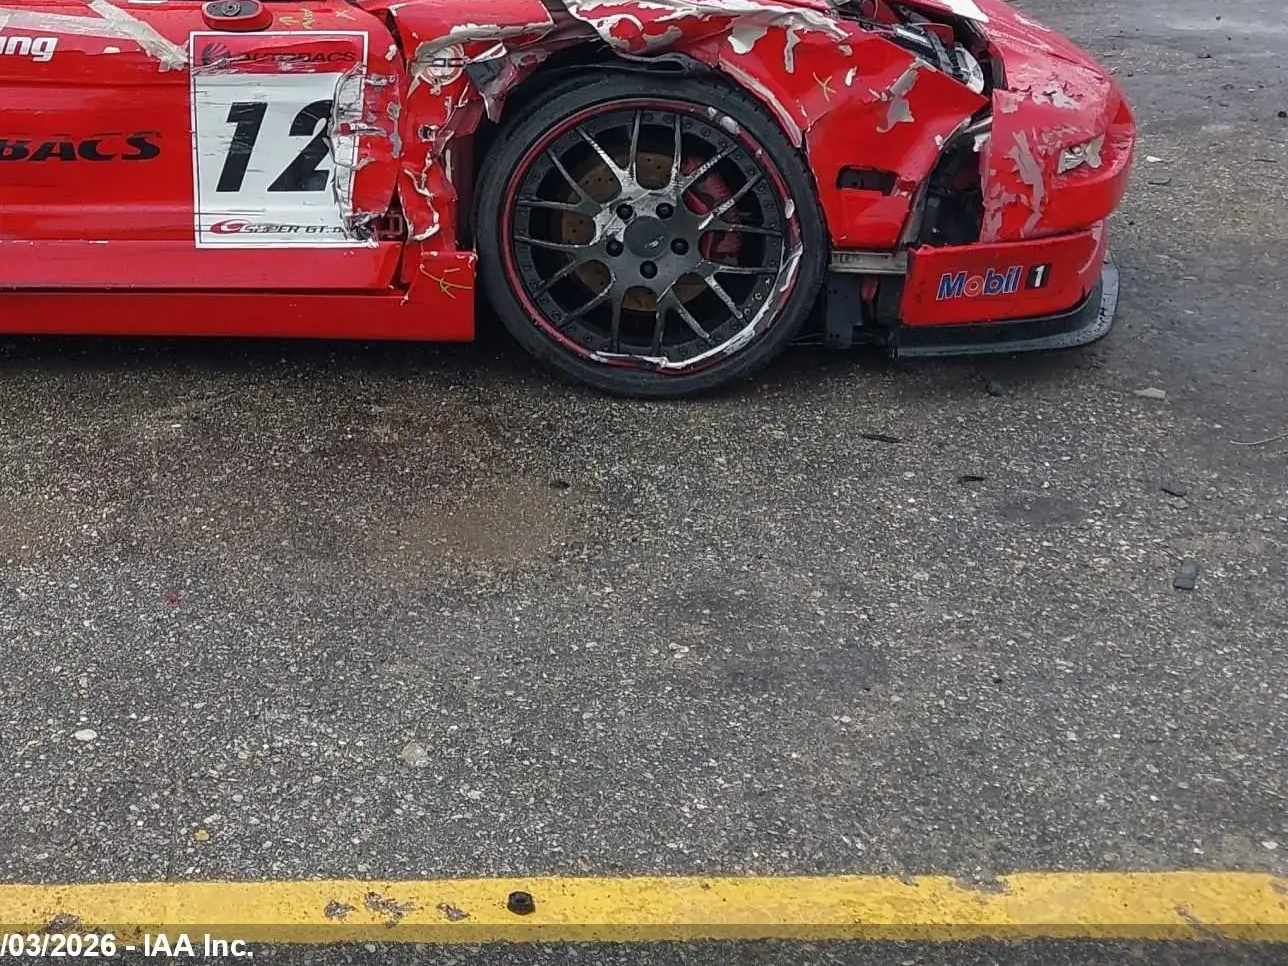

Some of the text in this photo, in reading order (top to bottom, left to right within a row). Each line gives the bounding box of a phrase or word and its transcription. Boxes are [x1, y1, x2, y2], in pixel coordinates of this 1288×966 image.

[215, 99, 334, 193] 12
[936, 264, 1046, 301] Mobil 1
